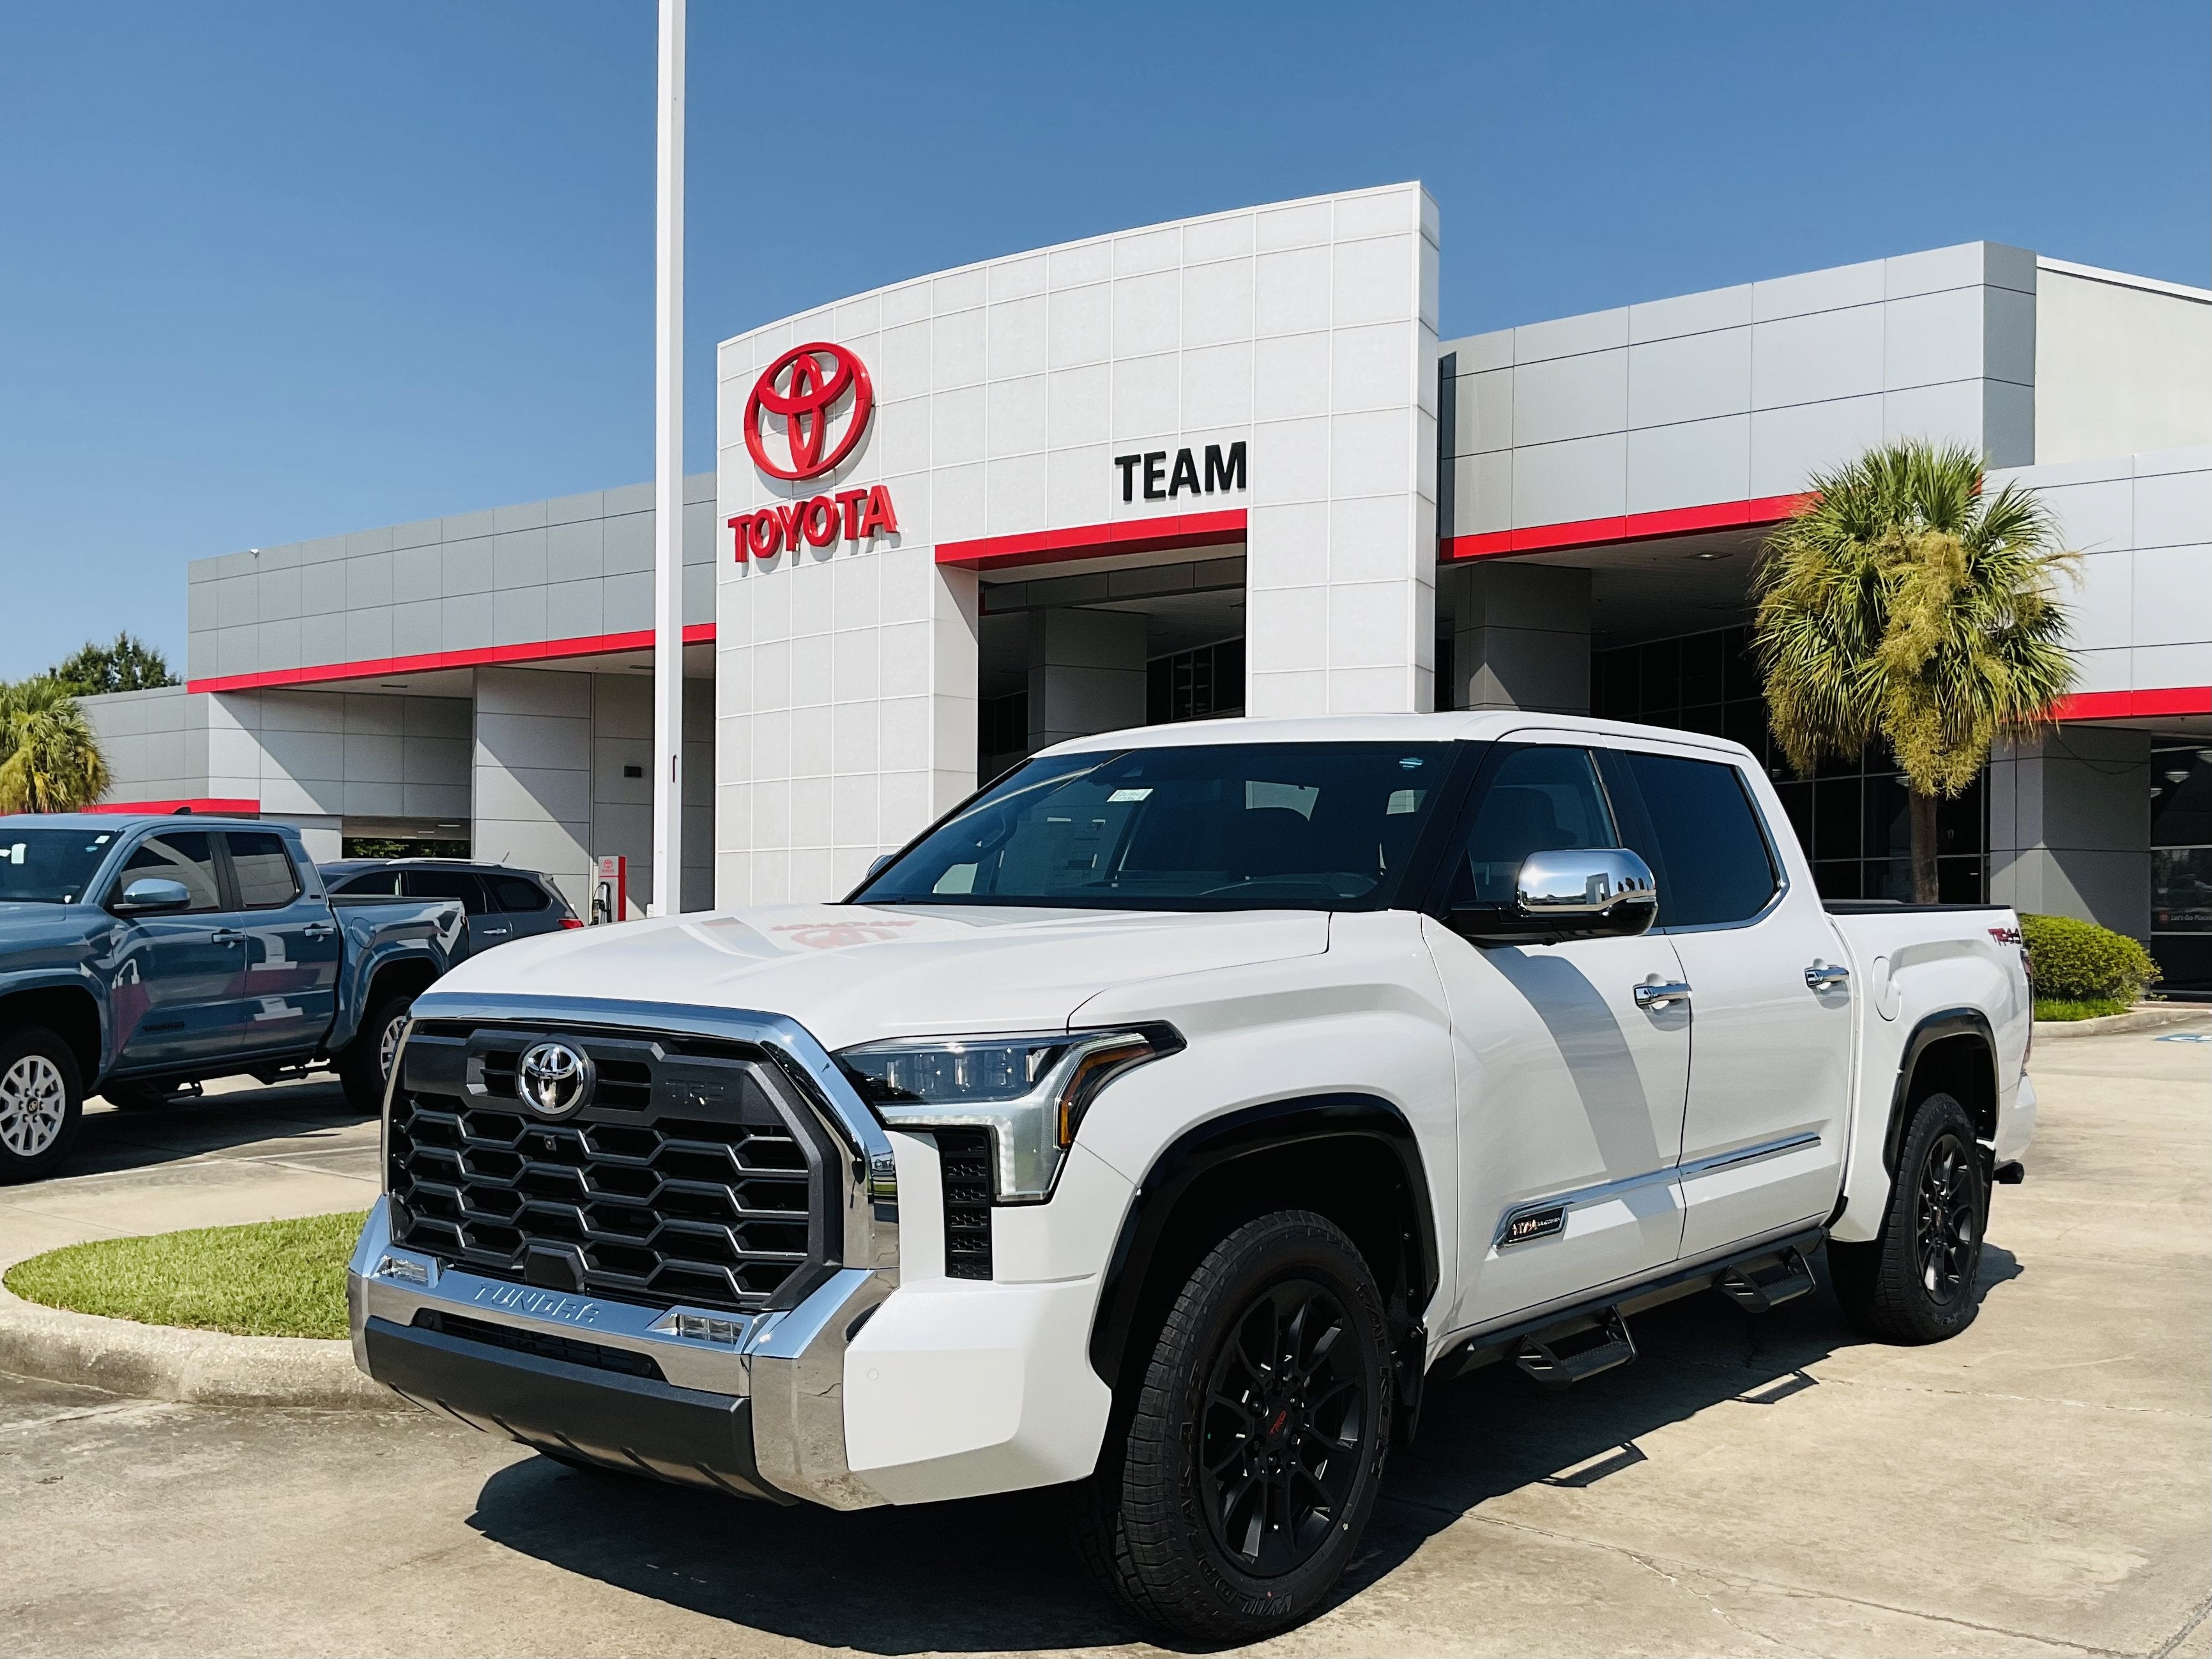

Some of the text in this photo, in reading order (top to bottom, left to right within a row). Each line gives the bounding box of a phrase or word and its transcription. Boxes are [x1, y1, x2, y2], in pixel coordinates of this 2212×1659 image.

[1115, 441, 1247, 501] TEAM
[728, 484, 899, 563] TOYOTA
[474, 1282, 600, 1324] TUNDRA
[1269, 1410, 1287, 1437] TRD
